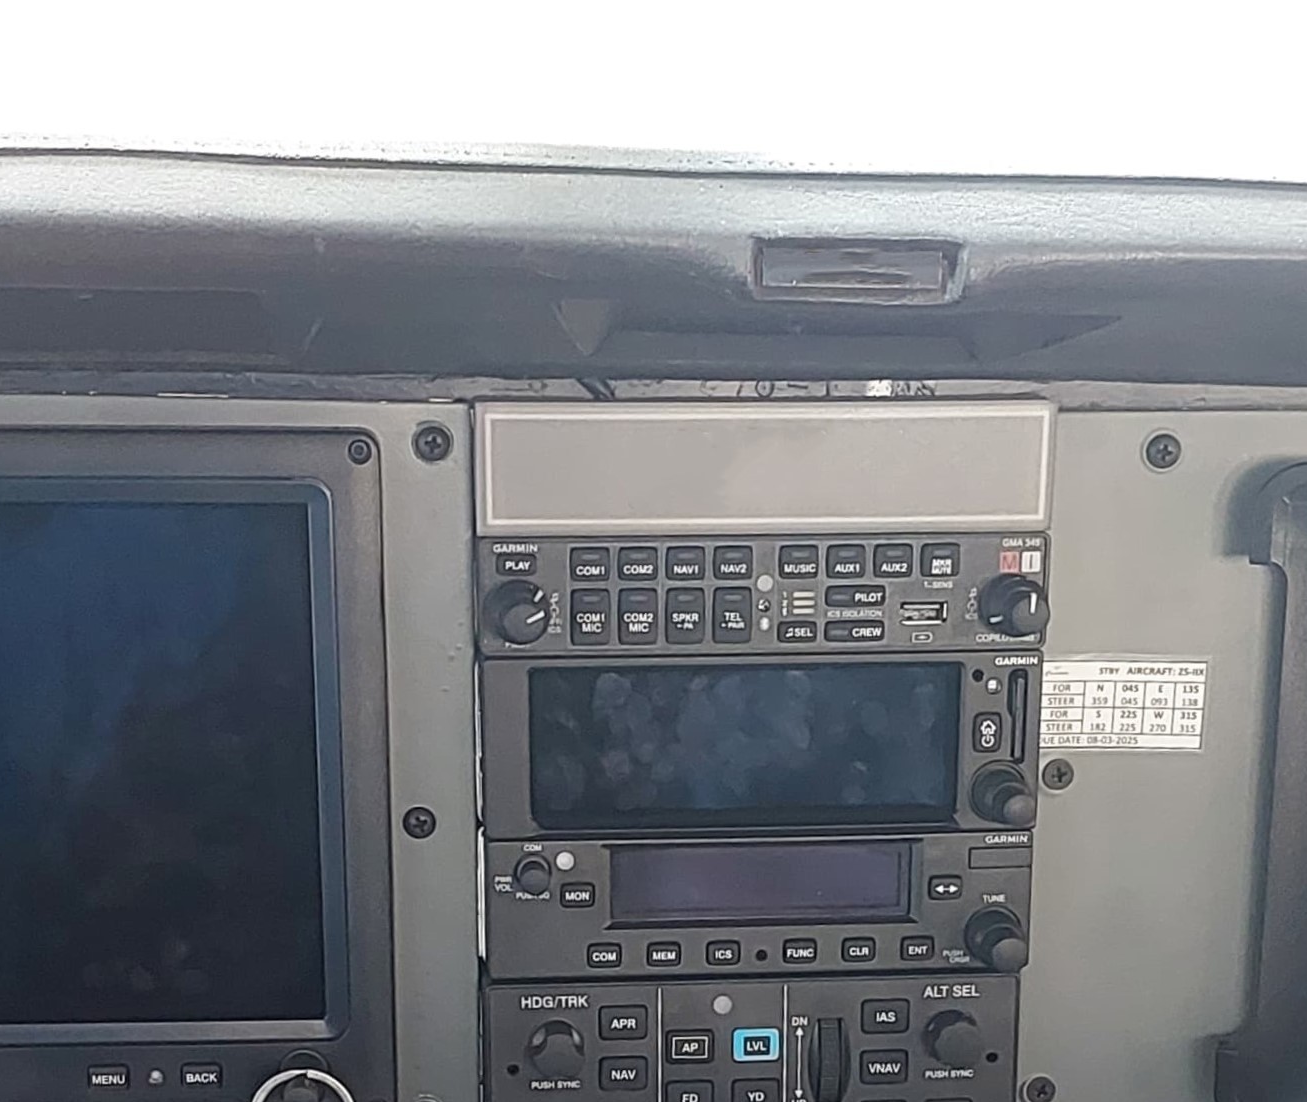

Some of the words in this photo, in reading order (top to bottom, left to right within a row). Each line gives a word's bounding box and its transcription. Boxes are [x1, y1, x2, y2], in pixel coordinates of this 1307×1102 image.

[493, 544, 538, 552] GARMIN
[505, 561, 530, 571] PLAY
[576, 565, 605, 575] COM1
[623, 565, 653, 575] COM2
[673, 565, 699, 574] NAV1
[721, 563, 746, 573] NAV2
[784, 563, 815, 574] MUSIC
[834, 563, 860, 573] AUX1
[881, 562, 907, 573] AUX2
[854, 592, 883, 603] PILOT
[576, 613, 605, 622] COM1
[624, 613, 653, 622] COM2
[672, 613, 699, 622] SPKR
[724, 612, 741, 621] TEL
[582, 623, 602, 632] MIC
[629, 623, 649, 632] MIC
[852, 628, 882, 637] CREW
[995, 657, 1038, 666] GARMIN
[1053, 684, 1071, 692] FOR
[1122, 685, 1139, 693] 045
[985, 835, 1028, 844] GARMIN
[565, 892, 589, 900] MON
[983, 895, 1005, 903] TUNE
[715, 950, 732, 959] ICS
[787, 948, 814, 957] FUNC
[850, 947, 868, 956] CLR
[908, 946, 928, 955] ENT
[593, 953, 616, 962] COM
[653, 951, 675, 960] MEM
[924, 986, 949, 998] ALT
[952, 986, 980, 997] SEL
[521, 996, 588, 1008] HDG/TRK
[792, 1017, 808, 1026] DN
[876, 1012, 896, 1022] IAS
[611, 1019, 636, 1029] APR
[682, 1043, 699, 1052] AP
[746, 1041, 766, 1051] LVL
[869, 1064, 901, 1074] VNAV
[92, 1074, 125, 1084] MENU
[186, 1073, 217, 1083] BACK
[611, 1070, 636, 1080] NAV
[925, 1071, 948, 1079] PUSH
[557, 1081, 581, 1089] SYNC
[748, 1092, 764, 1102] YD
